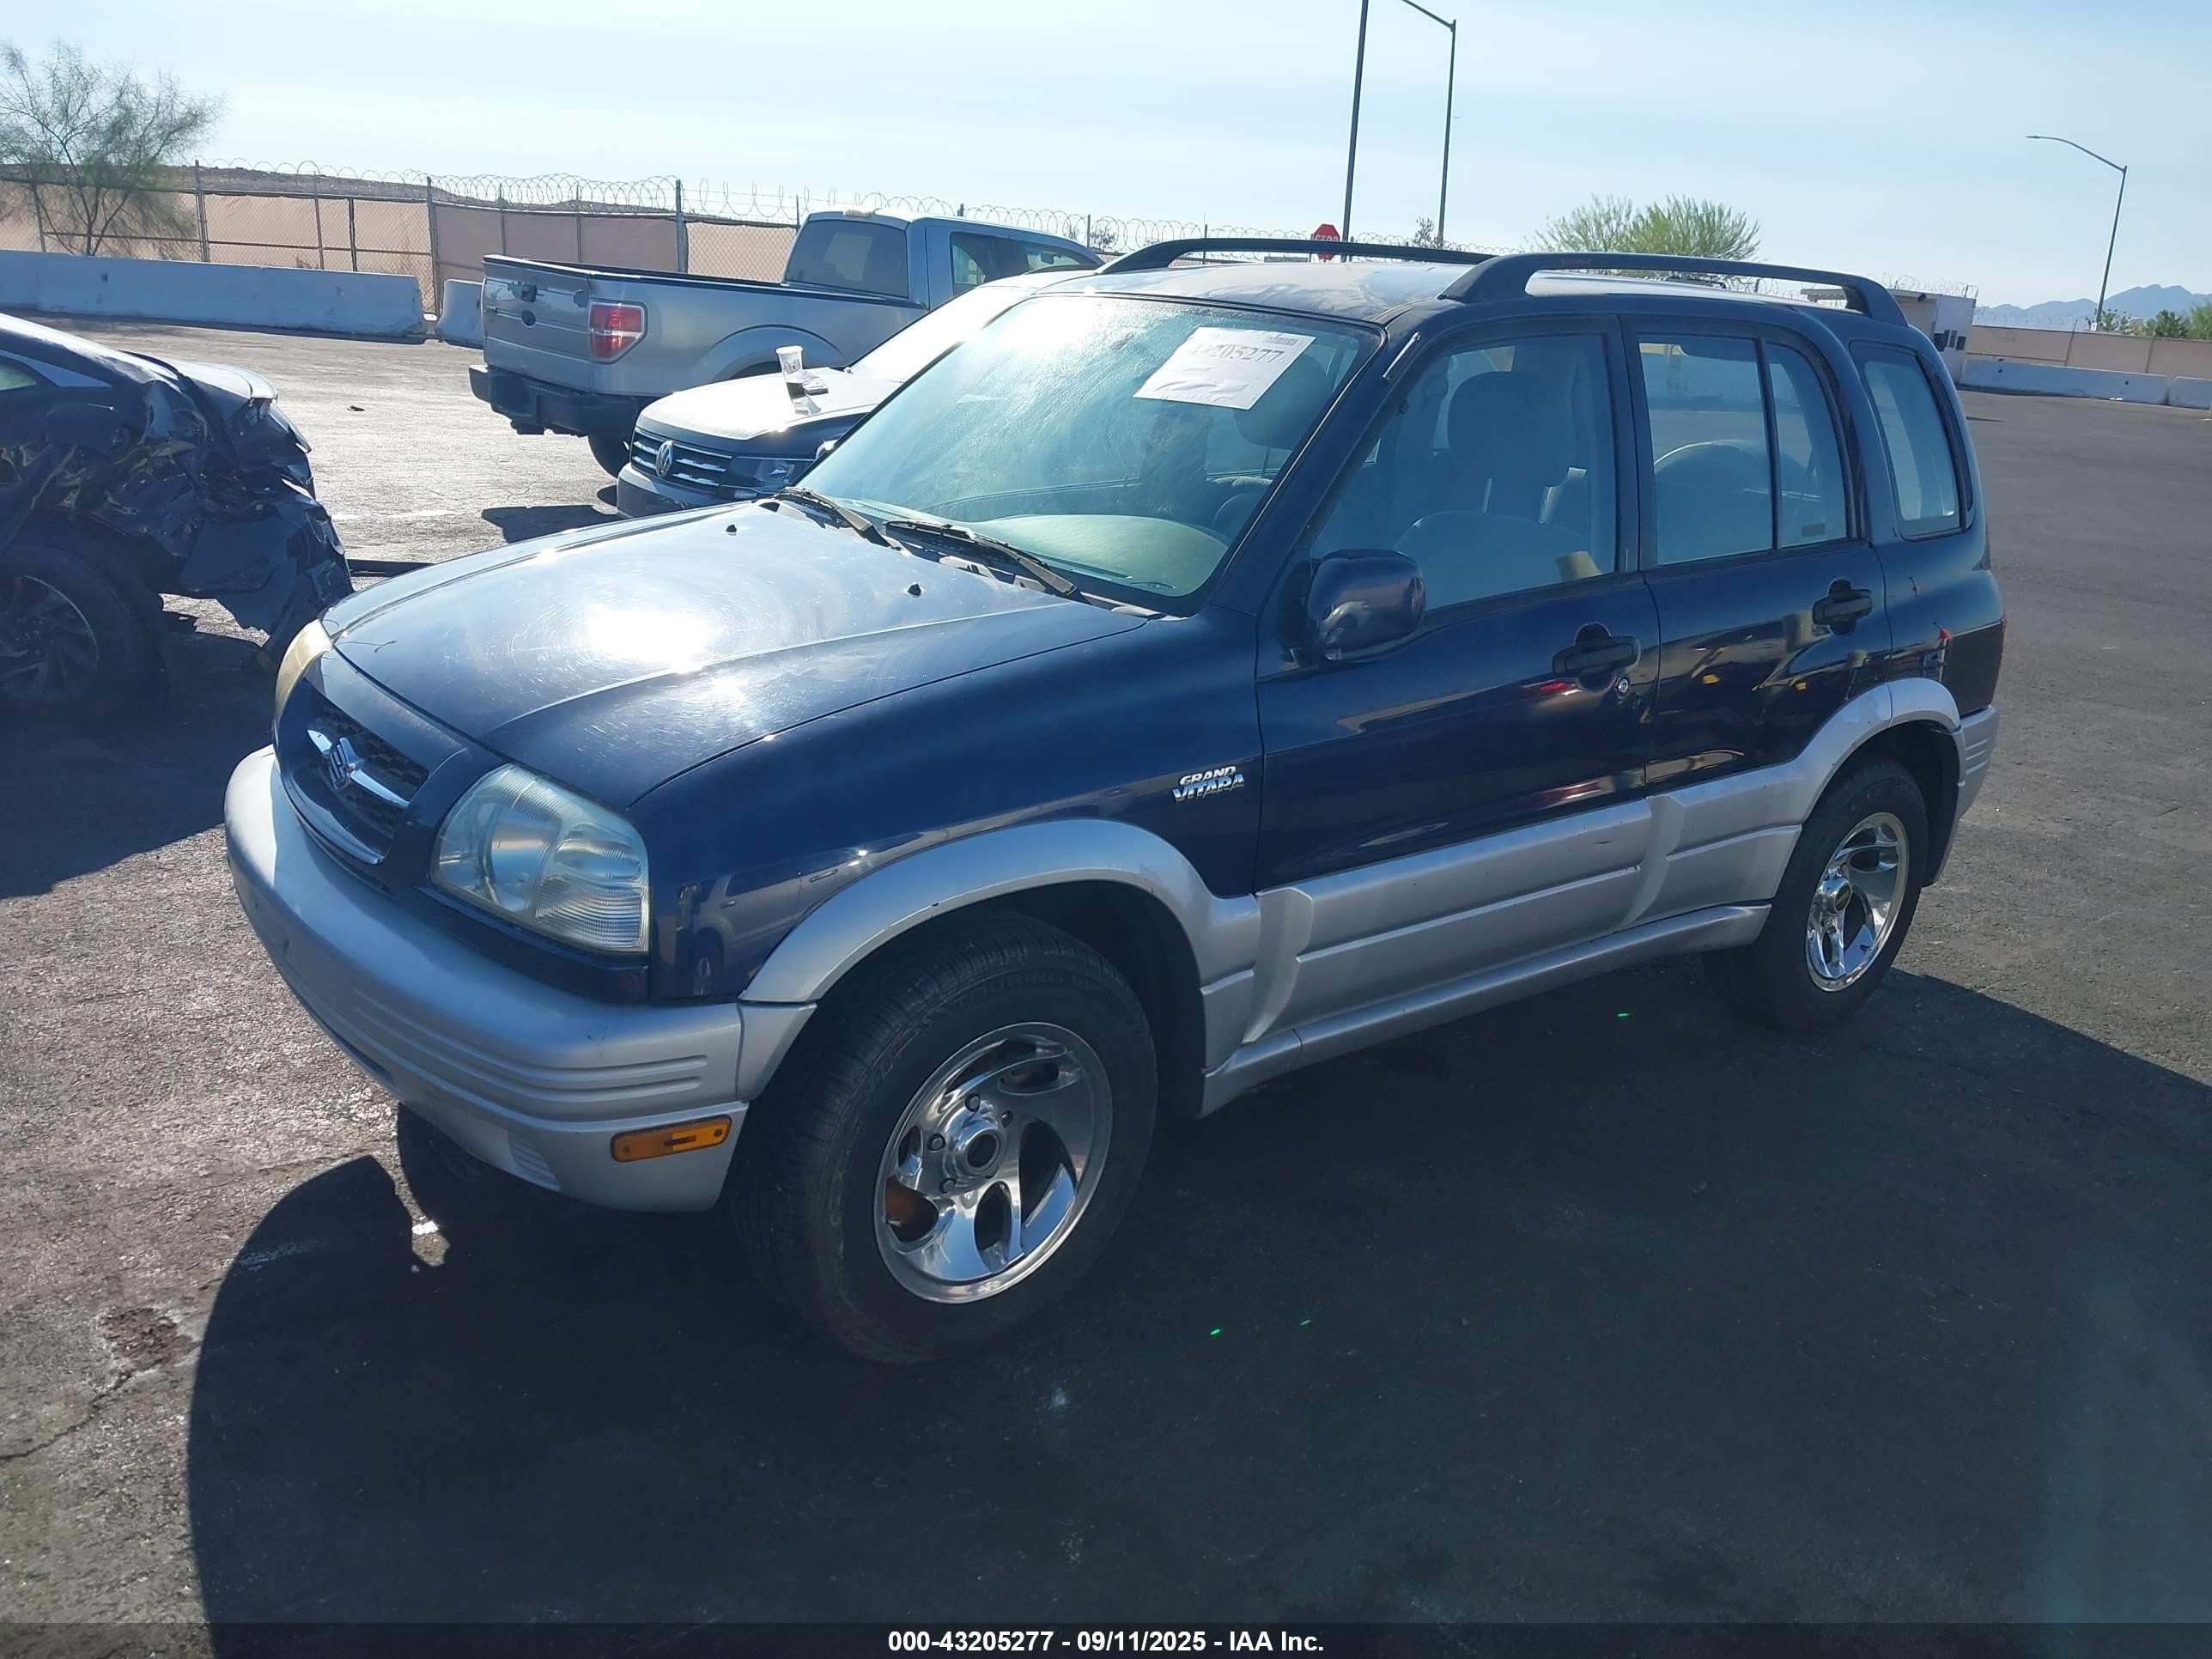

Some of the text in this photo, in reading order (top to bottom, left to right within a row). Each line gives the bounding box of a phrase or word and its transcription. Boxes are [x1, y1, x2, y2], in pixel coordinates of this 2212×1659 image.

[1188, 344, 1285, 363] 205277
[1179, 765, 1237, 786] GRAND
[1172, 773, 1244, 800] VITARA
